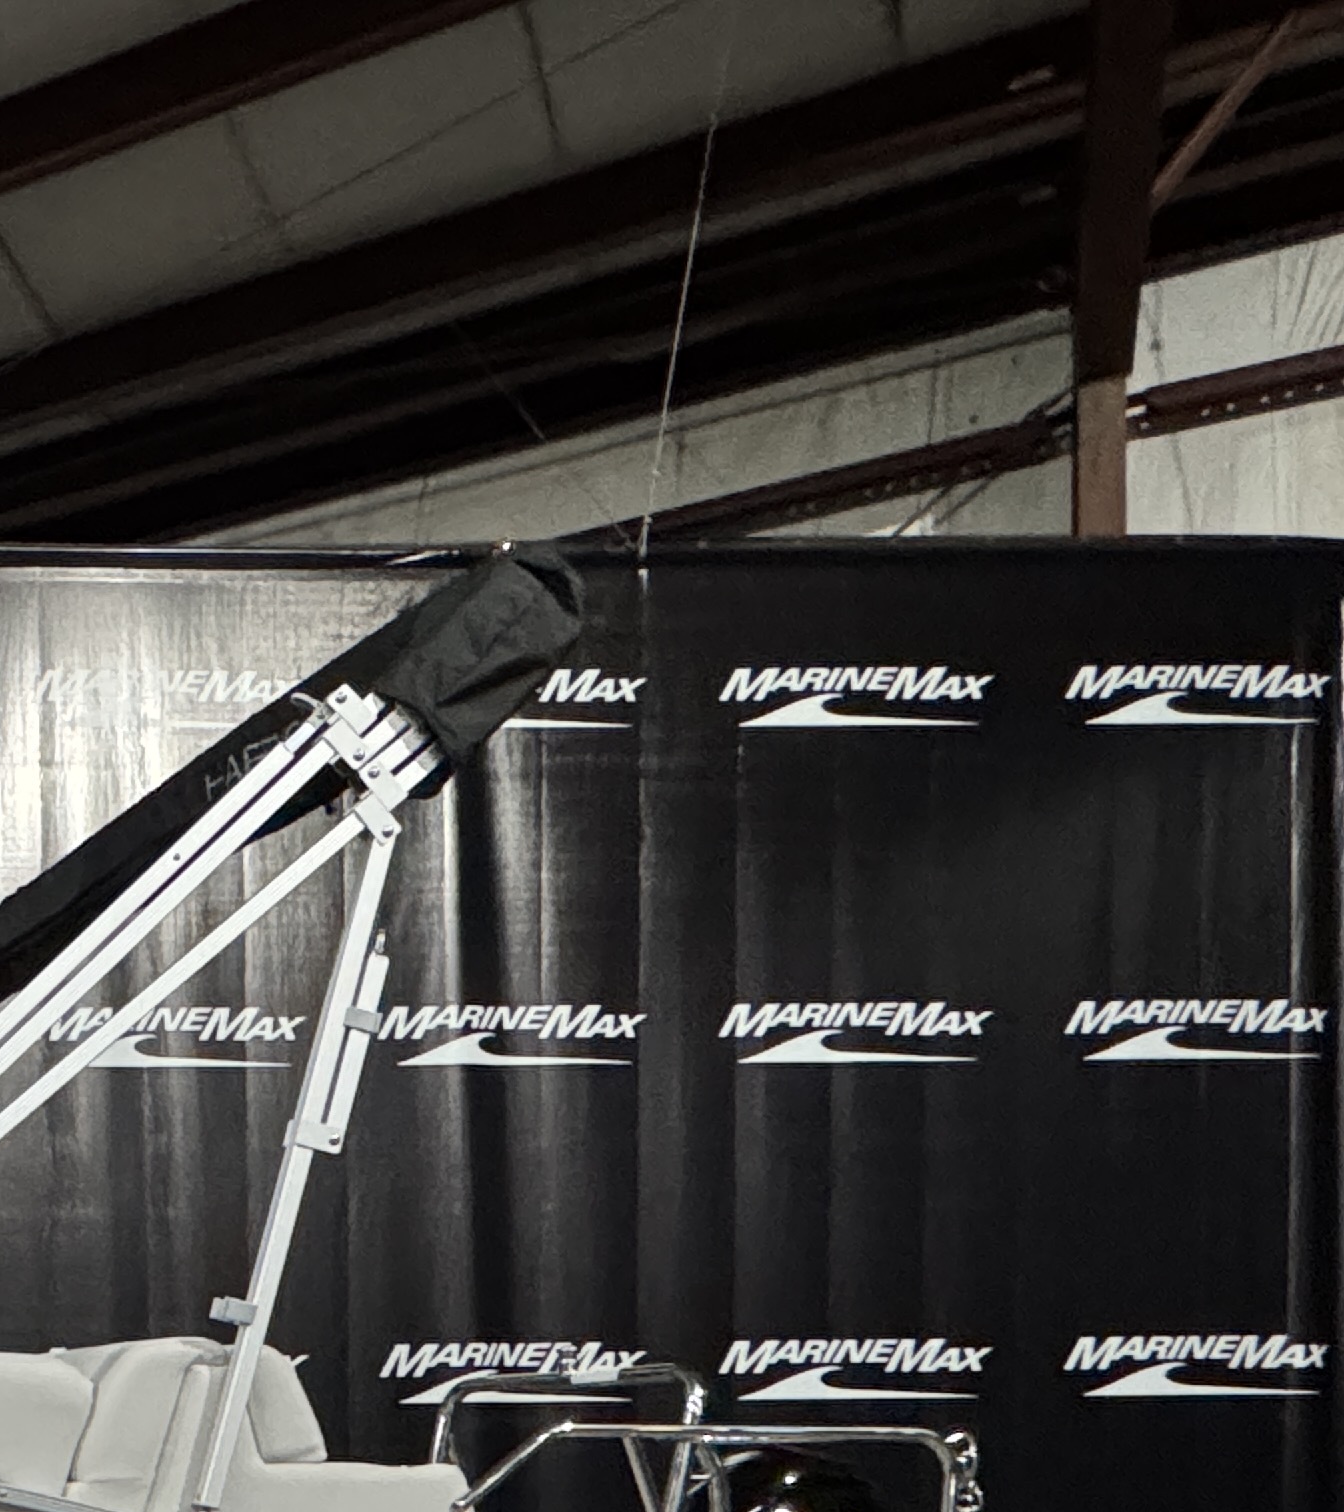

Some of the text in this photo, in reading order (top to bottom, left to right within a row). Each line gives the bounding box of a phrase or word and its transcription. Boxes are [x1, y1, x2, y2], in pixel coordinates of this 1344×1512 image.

[31, 669, 302, 701] MANEMAX
[719, 666, 994, 702] MARINEMAX
[1064, 665, 1331, 699] MARINEMAX
[48, 1006, 306, 1041] MAINEMAX
[719, 1002, 994, 1038] MARINEMAX
[1064, 1000, 1328, 1035] MARINEMAX
[720, 1339, 994, 1375] MARINEMAX
[1064, 1335, 1329, 1373] MARINEMAX
